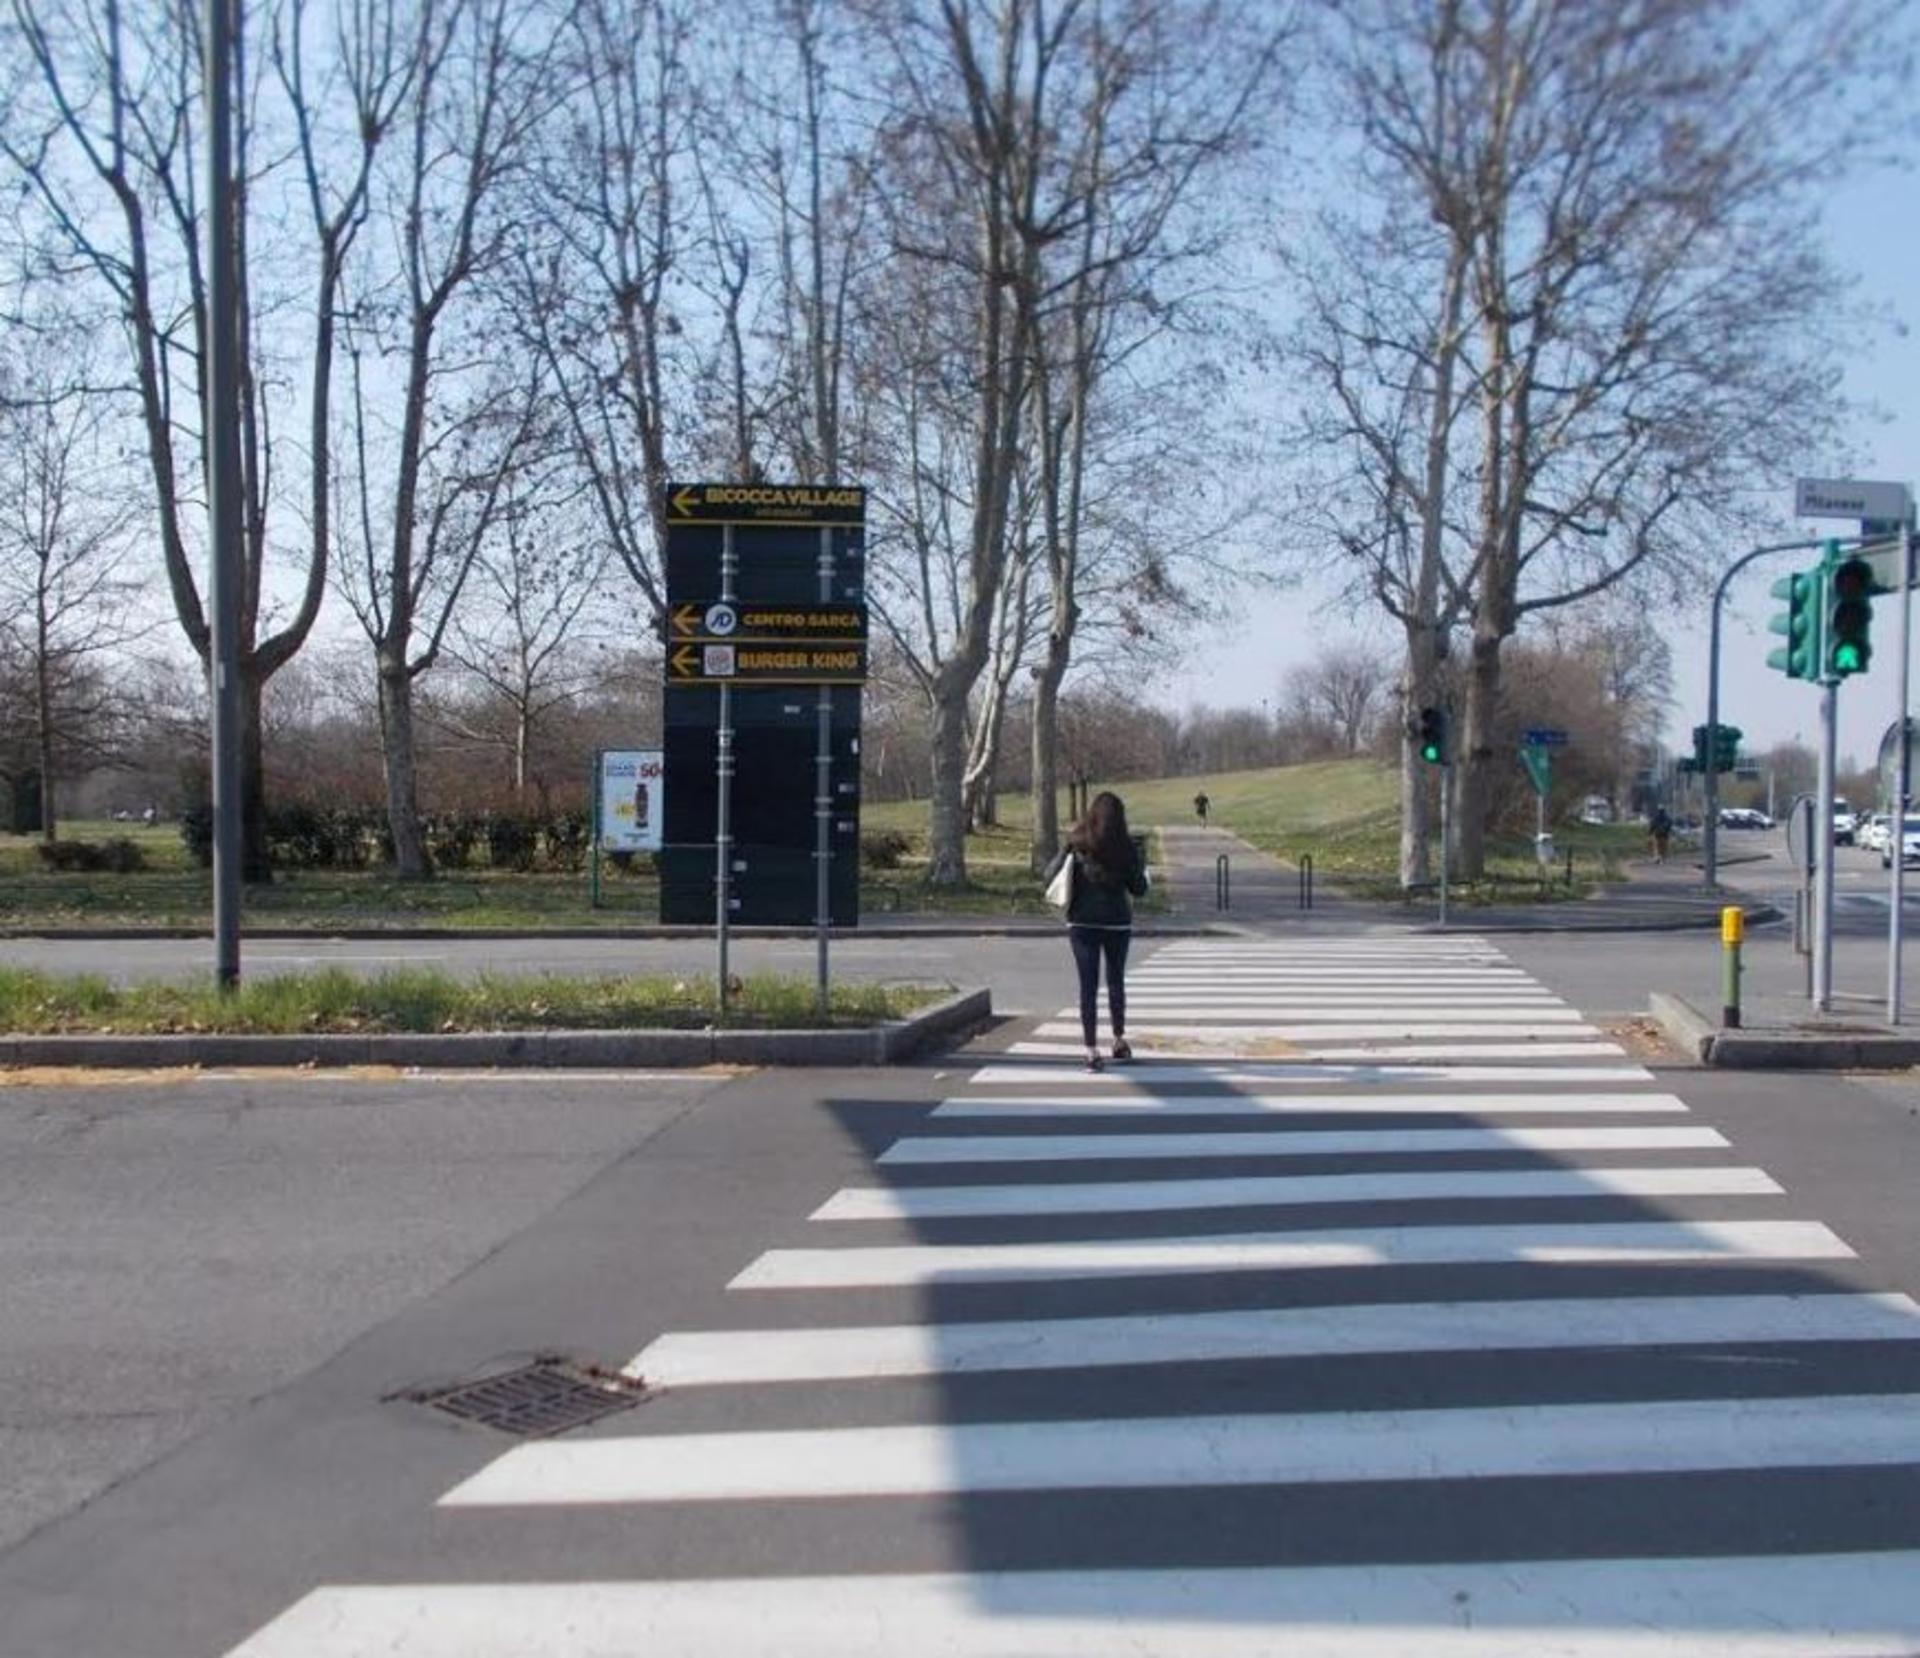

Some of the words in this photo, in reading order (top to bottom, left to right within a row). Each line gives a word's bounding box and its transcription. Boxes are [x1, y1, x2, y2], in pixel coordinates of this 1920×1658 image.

[706, 488, 786, 504] BICOCCA
[788, 490, 861, 506] VILLAGE
[742, 613, 805, 626] CENTRO
[807, 614, 860, 627] SARCA
[738, 652, 808, 668] BURGER
[812, 652, 858, 669] KING
